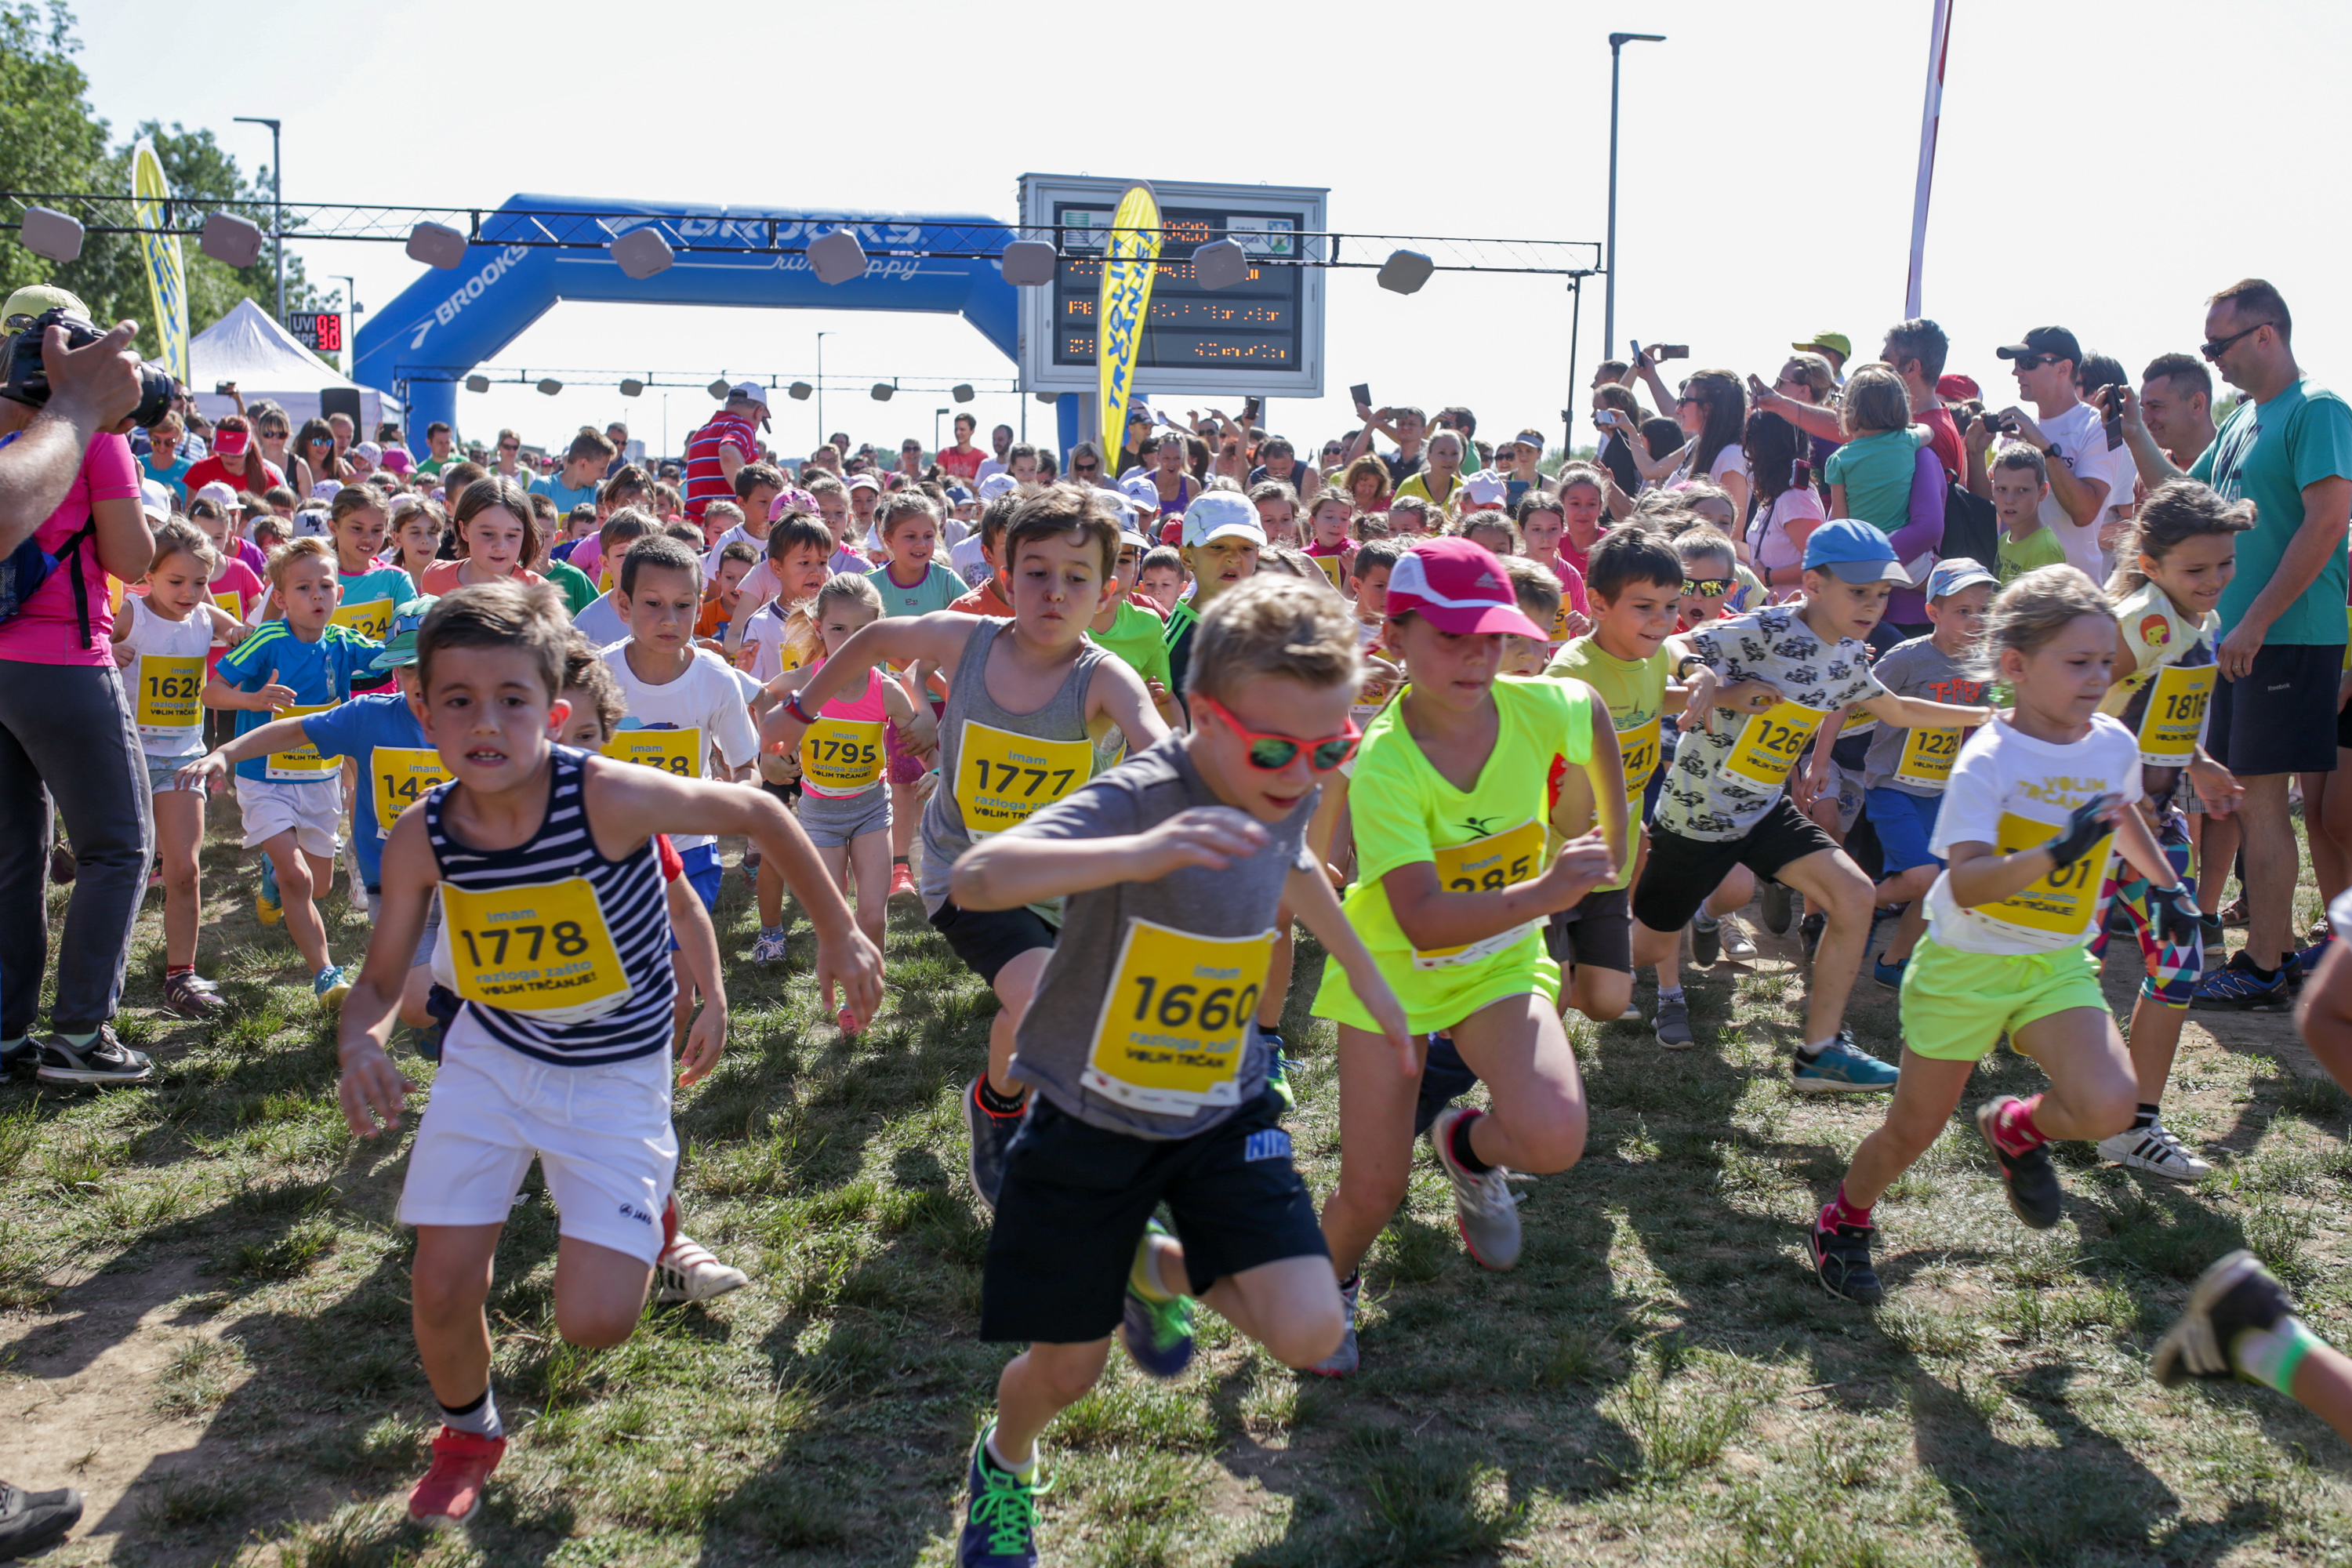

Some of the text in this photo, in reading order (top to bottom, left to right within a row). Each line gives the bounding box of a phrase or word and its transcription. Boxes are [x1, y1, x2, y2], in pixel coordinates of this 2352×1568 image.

[435, 237, 530, 326] BROOKS
[292, 314, 339, 332] UVI 03
[318, 331, 340, 350] 30
[2259, 682, 2290, 691] Reebok
[832, 731, 858, 740] Imam
[811, 739, 877, 764] 1795
[1008, 750, 1047, 765] Imam
[1915, 754, 1944, 764] razloga
[408, 764, 441, 773] Imam
[811, 762, 845, 772] razloga
[811, 769, 834, 778] VOLIM
[976, 760, 1075, 797] 1777
[2042, 777, 2107, 793] VOLIM
[975, 796, 1026, 811] razloga
[974, 807, 1009, 818] VOLIM
[1461, 854, 1502, 872] Imam
[485, 909, 538, 923] Imam
[461, 920, 589, 967] 1778
[474, 960, 593, 983] razloga zašto
[480, 971, 597, 995] VOLIM TRČANJE!
[1134, 976, 1258, 1032] 1660
[1128, 1031, 1200, 1052] razloga
[1126, 1047, 1173, 1064] VOLIM
